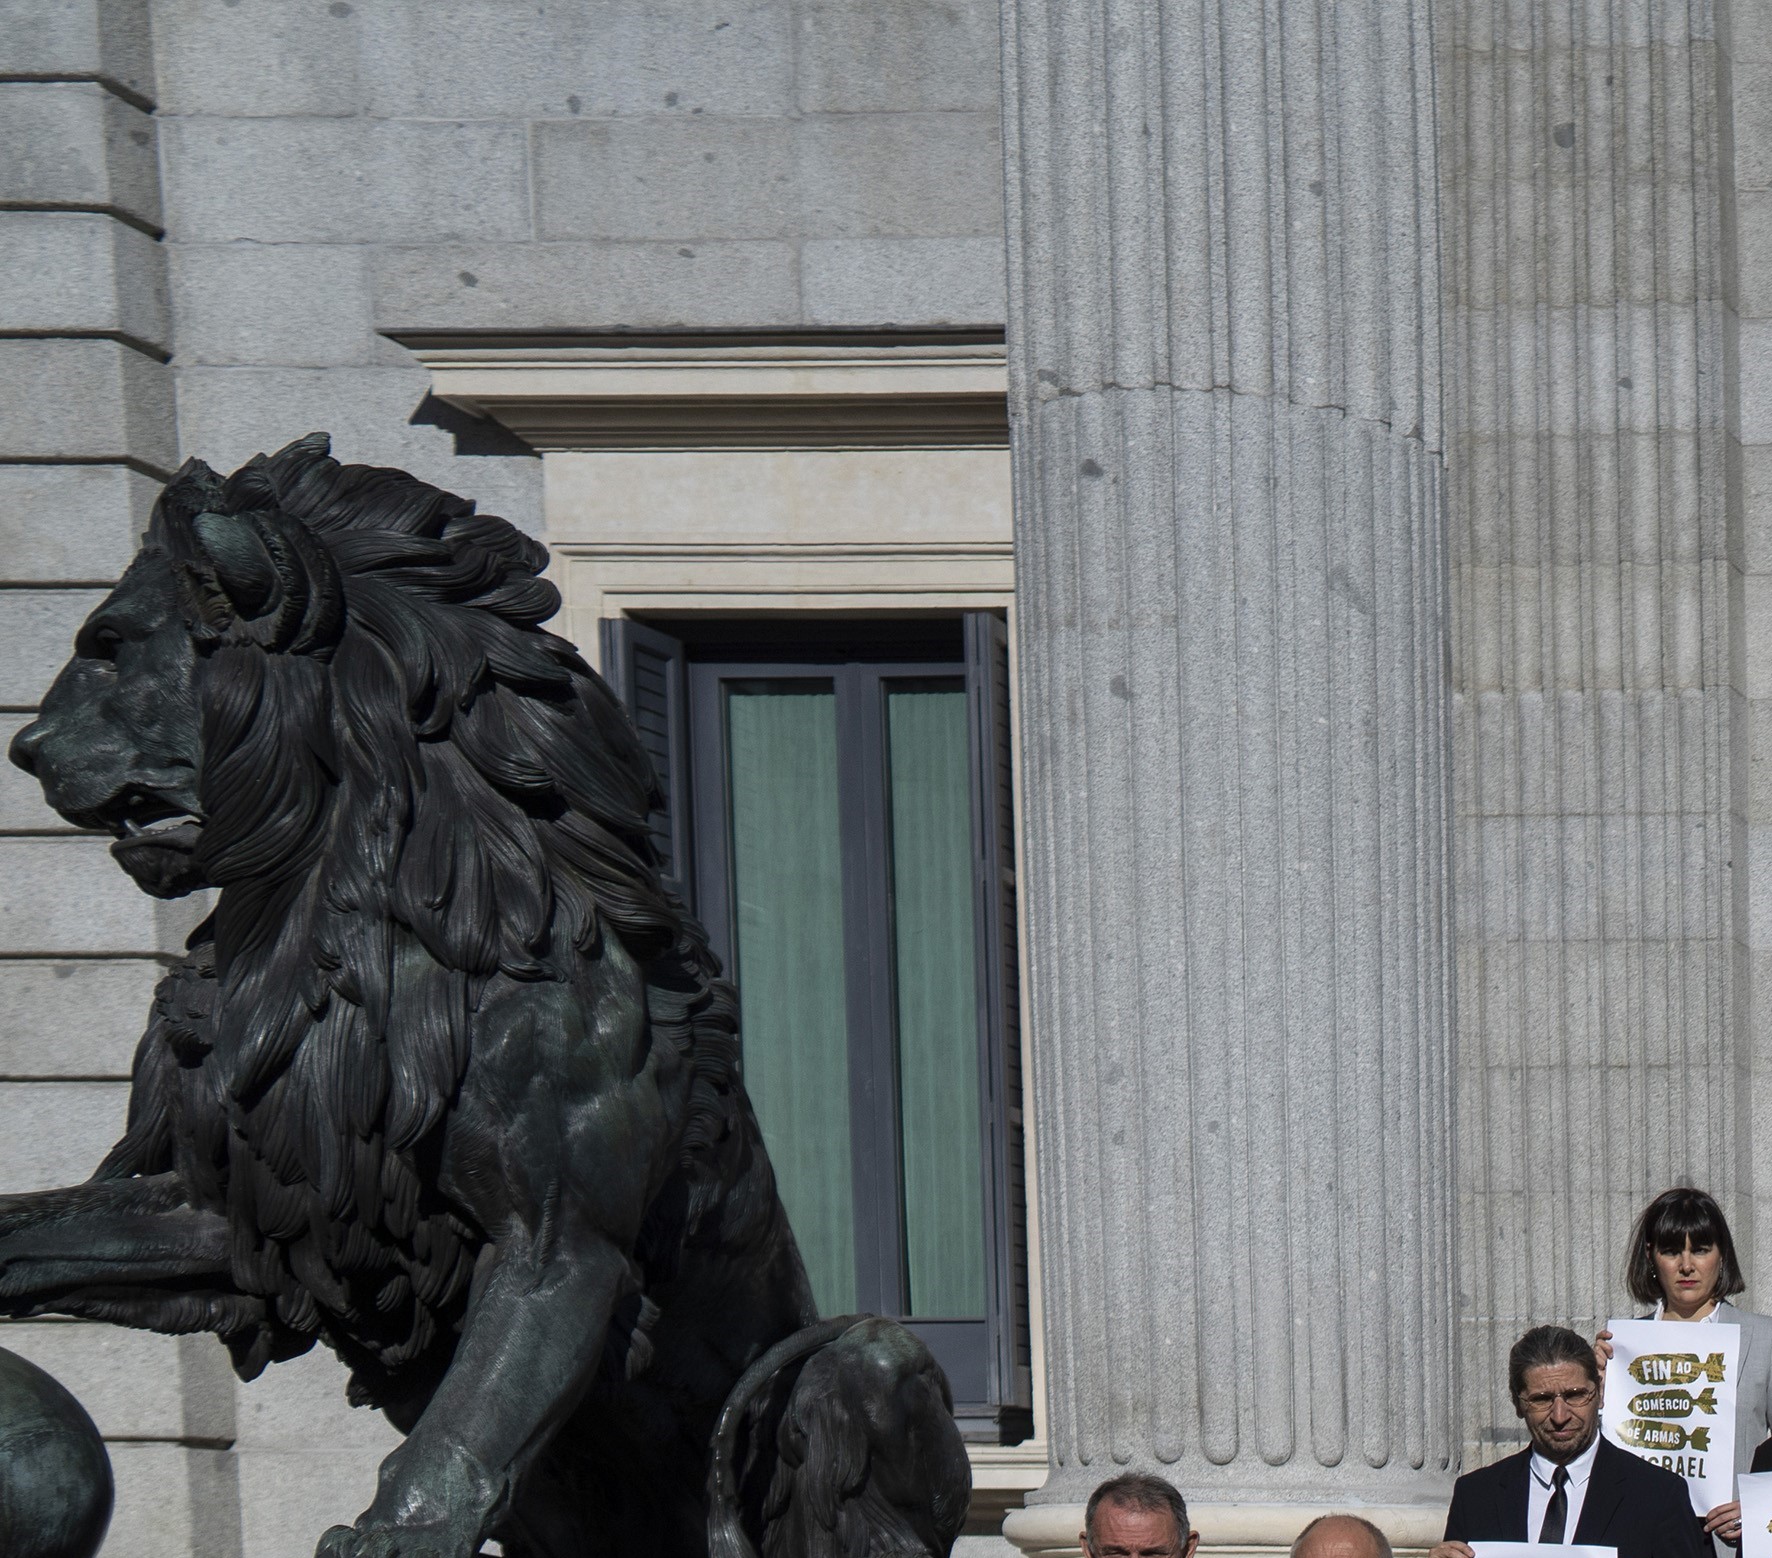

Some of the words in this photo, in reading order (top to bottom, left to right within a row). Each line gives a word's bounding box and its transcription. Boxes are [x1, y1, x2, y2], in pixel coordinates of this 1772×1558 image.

[1642, 1359, 1672, 1382] FIN
[1676, 1361, 1691, 1374] AO
[1635, 1399, 1690, 1412] COMERCIO
[1644, 1430, 1680, 1445] ARMAS
